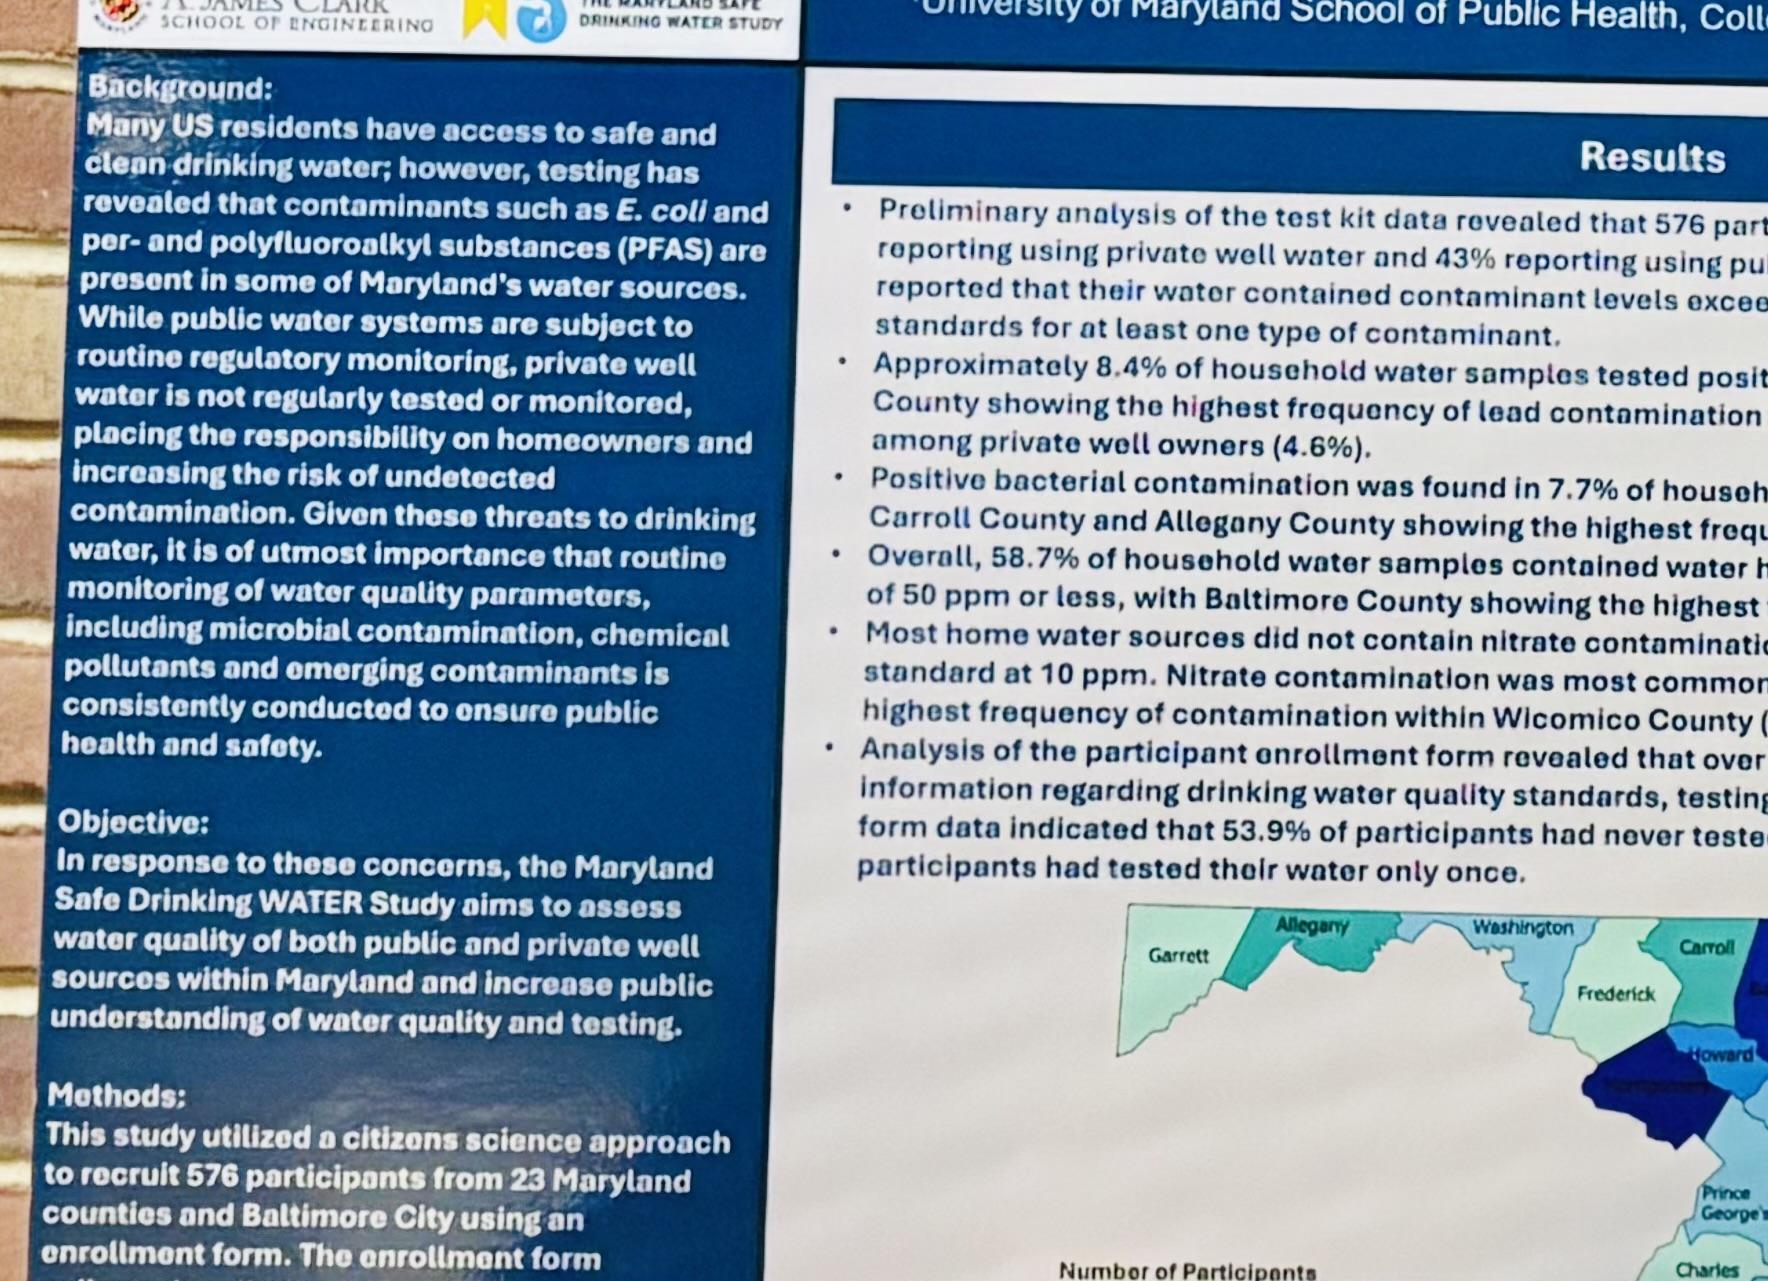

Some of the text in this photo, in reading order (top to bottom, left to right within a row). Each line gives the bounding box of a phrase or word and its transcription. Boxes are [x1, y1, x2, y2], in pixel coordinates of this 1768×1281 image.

[161, 13, 434, 33] SCHOOL OF ENGINEERING
[579, 13, 784, 31] DRINKING WATER STUDY
[88, 71, 272, 107] Background:
[87, 111, 717, 147] Many US residents have access to safe and
[1581, 140, 1726, 174] Results
[876, 314, 1561, 348] standards for at least one type of contaminant.
[57, 807, 209, 839] Objective:
[54, 885, 682, 922] Safe Drinking WATER Study aims to assess
[1276, 917, 1350, 936] Allegany
[1473, 919, 1574, 937] Washington
[1149, 948, 1209, 964] Garrett
[1680, 940, 1734, 956] Carroll
[1577, 985, 1656, 1002] Frederick
[47, 1081, 186, 1109] Methods:
[1702, 1186, 1750, 1201] Prince
[1059, 1261, 1149, 1281] Number
[1155, 1262, 1178, 1281] of
[1676, 1262, 1739, 1279] Charles
